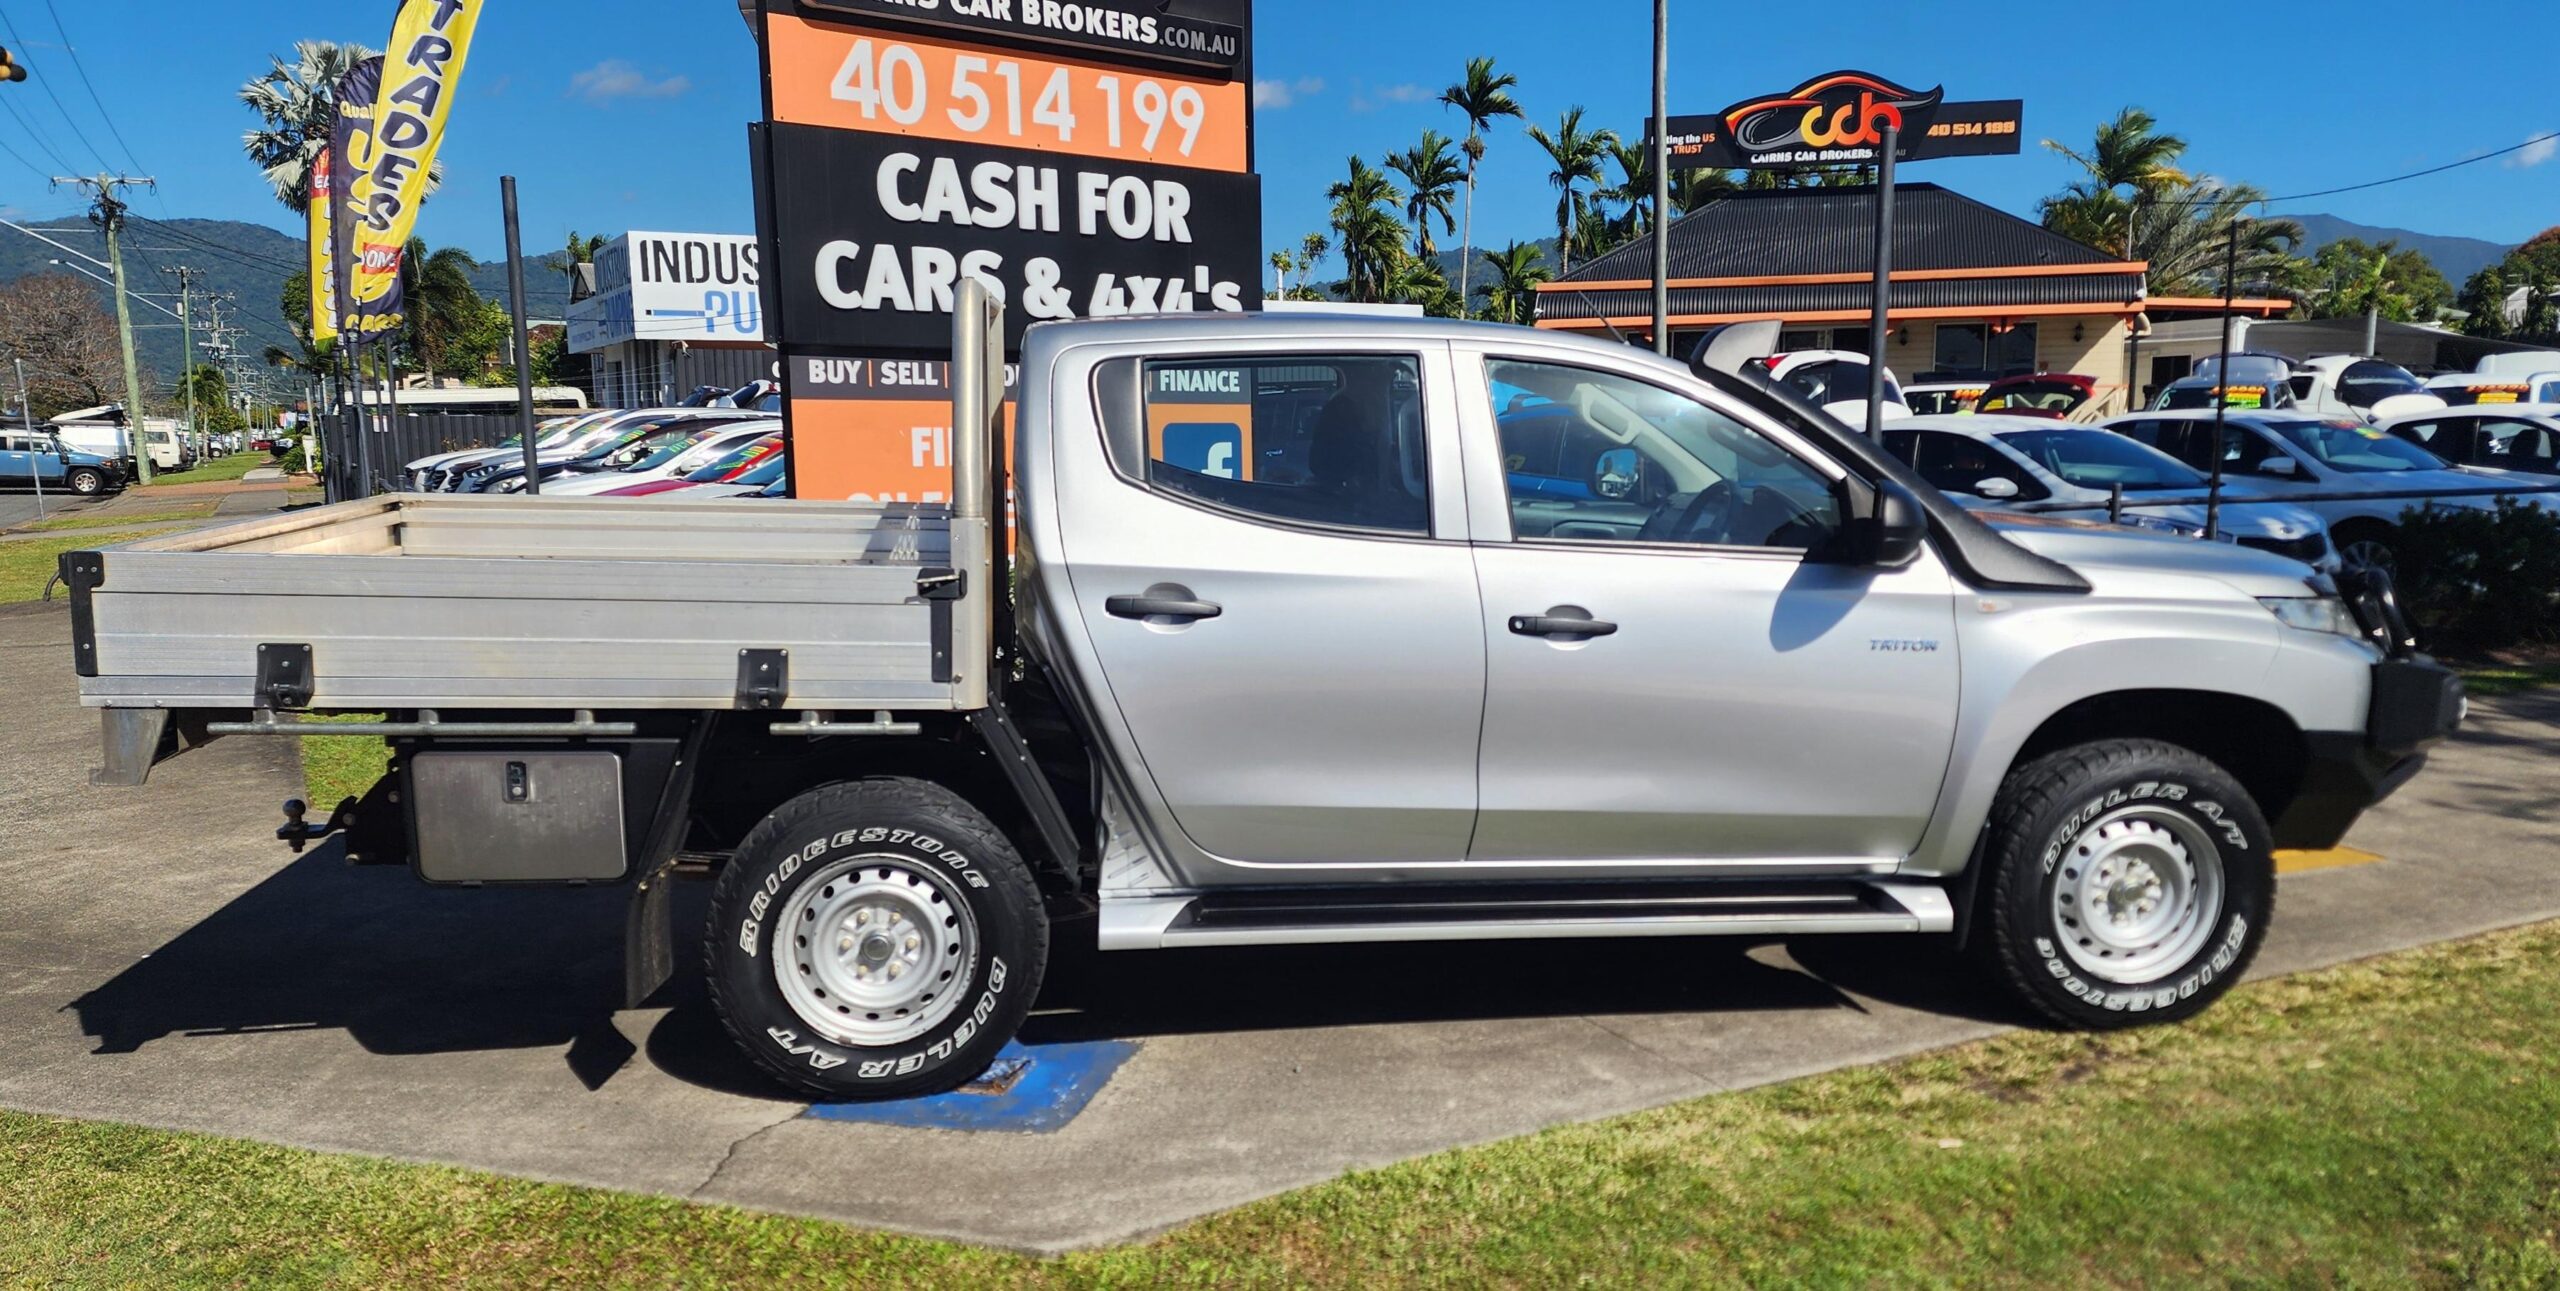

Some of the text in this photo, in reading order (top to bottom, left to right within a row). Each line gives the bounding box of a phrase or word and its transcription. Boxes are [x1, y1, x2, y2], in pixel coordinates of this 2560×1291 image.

[830, 39, 1205, 158] 40 514 199
[1702, 133, 1716, 142] US
[1927, 121, 1950, 136] 40
[1952, 121, 1982, 136] 514
[1673, 144, 1703, 154] TRUST
[1751, 152, 1792, 163] CAIRNS
[1794, 151, 1817, 161] CAR
[876, 152, 1192, 243] CASH FOR
[815, 240, 1006, 313] CARS
[1023, 257, 1076, 318] &
[808, 360, 861, 384] BUY
[880, 362, 938, 386] SELL
[1160, 369, 1240, 393] FINANCE
[1870, 639, 1938, 651] TRITON
[2044, 781, 2248, 874] DUELER A/T
[739, 827, 989, 957] BRIDGESTONE
[2034, 913, 2248, 1012] BRIDGESTONE
[767, 956, 1007, 1077] DUELER A/T
